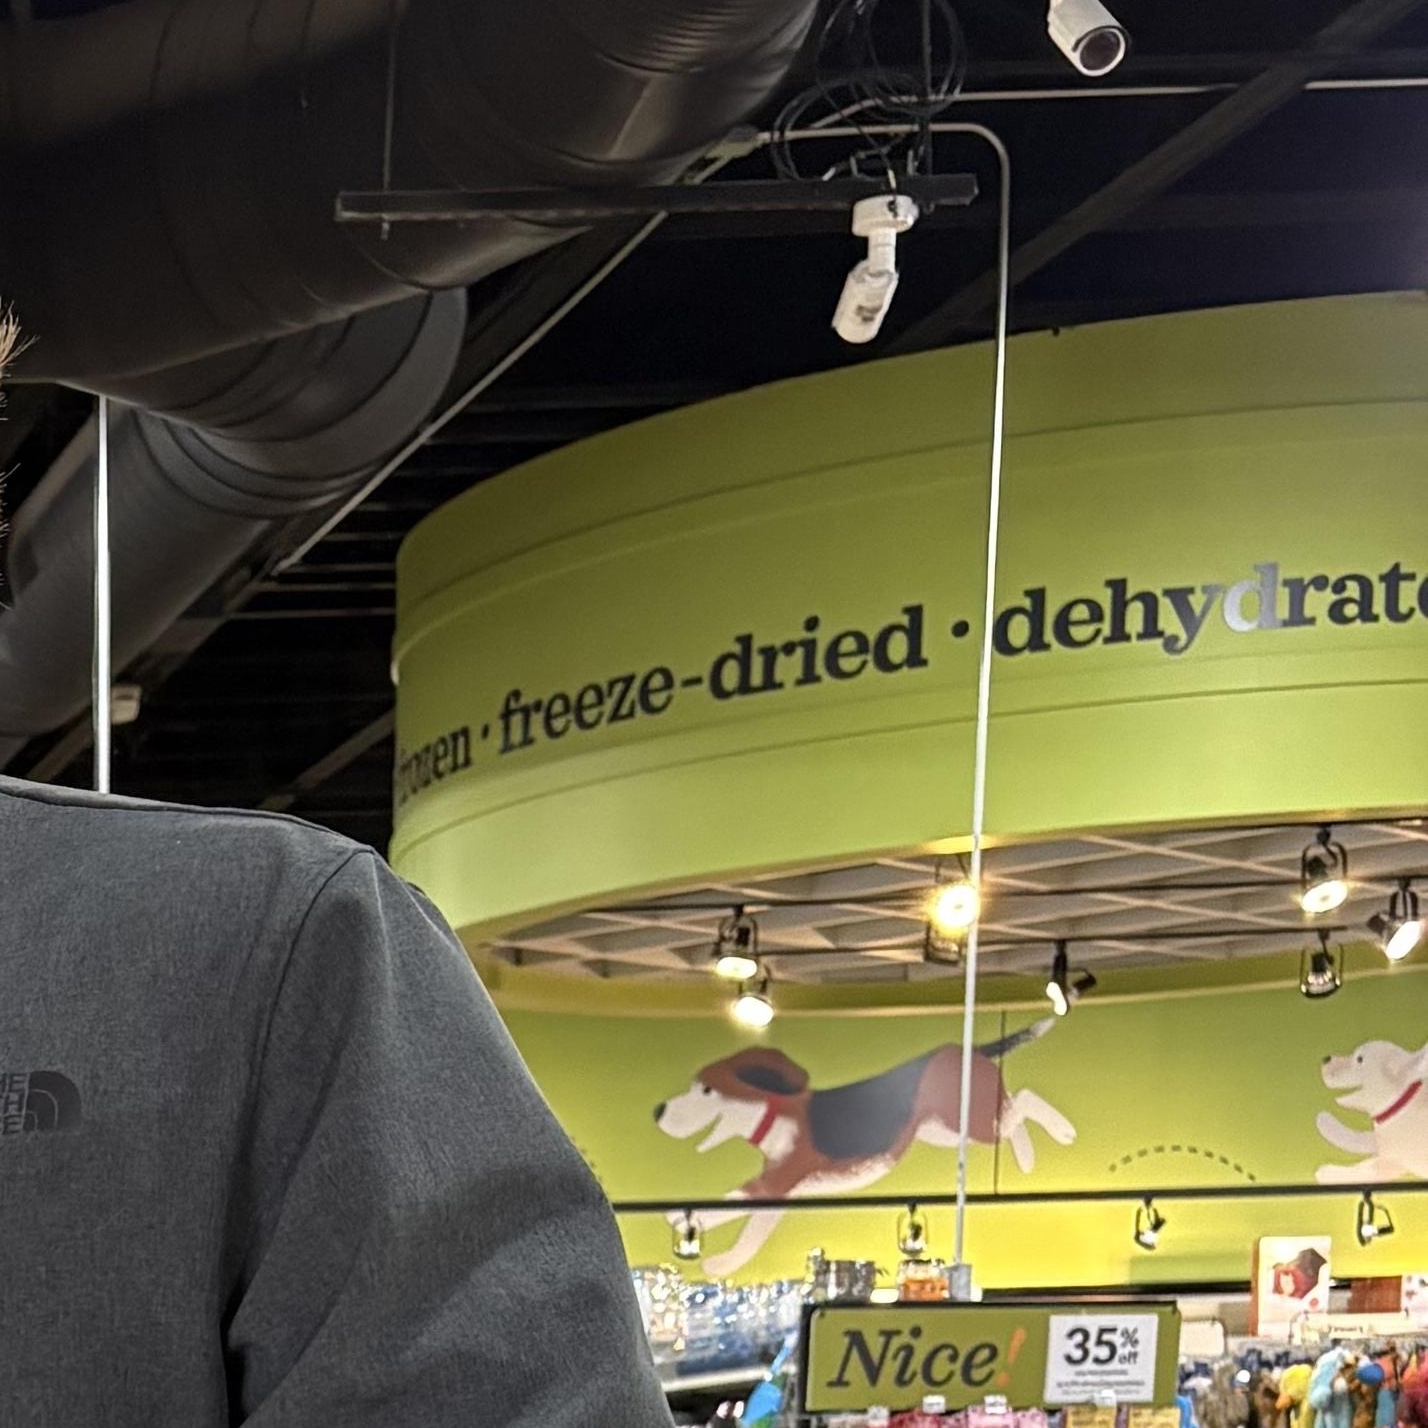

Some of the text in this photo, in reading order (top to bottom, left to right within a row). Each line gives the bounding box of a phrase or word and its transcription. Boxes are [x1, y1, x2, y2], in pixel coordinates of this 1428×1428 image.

[497, 605, 929, 756] freeze-dried
[992, 561, 1428, 656] dehydrat
[826, 1326, 1028, 1389] Nice!
